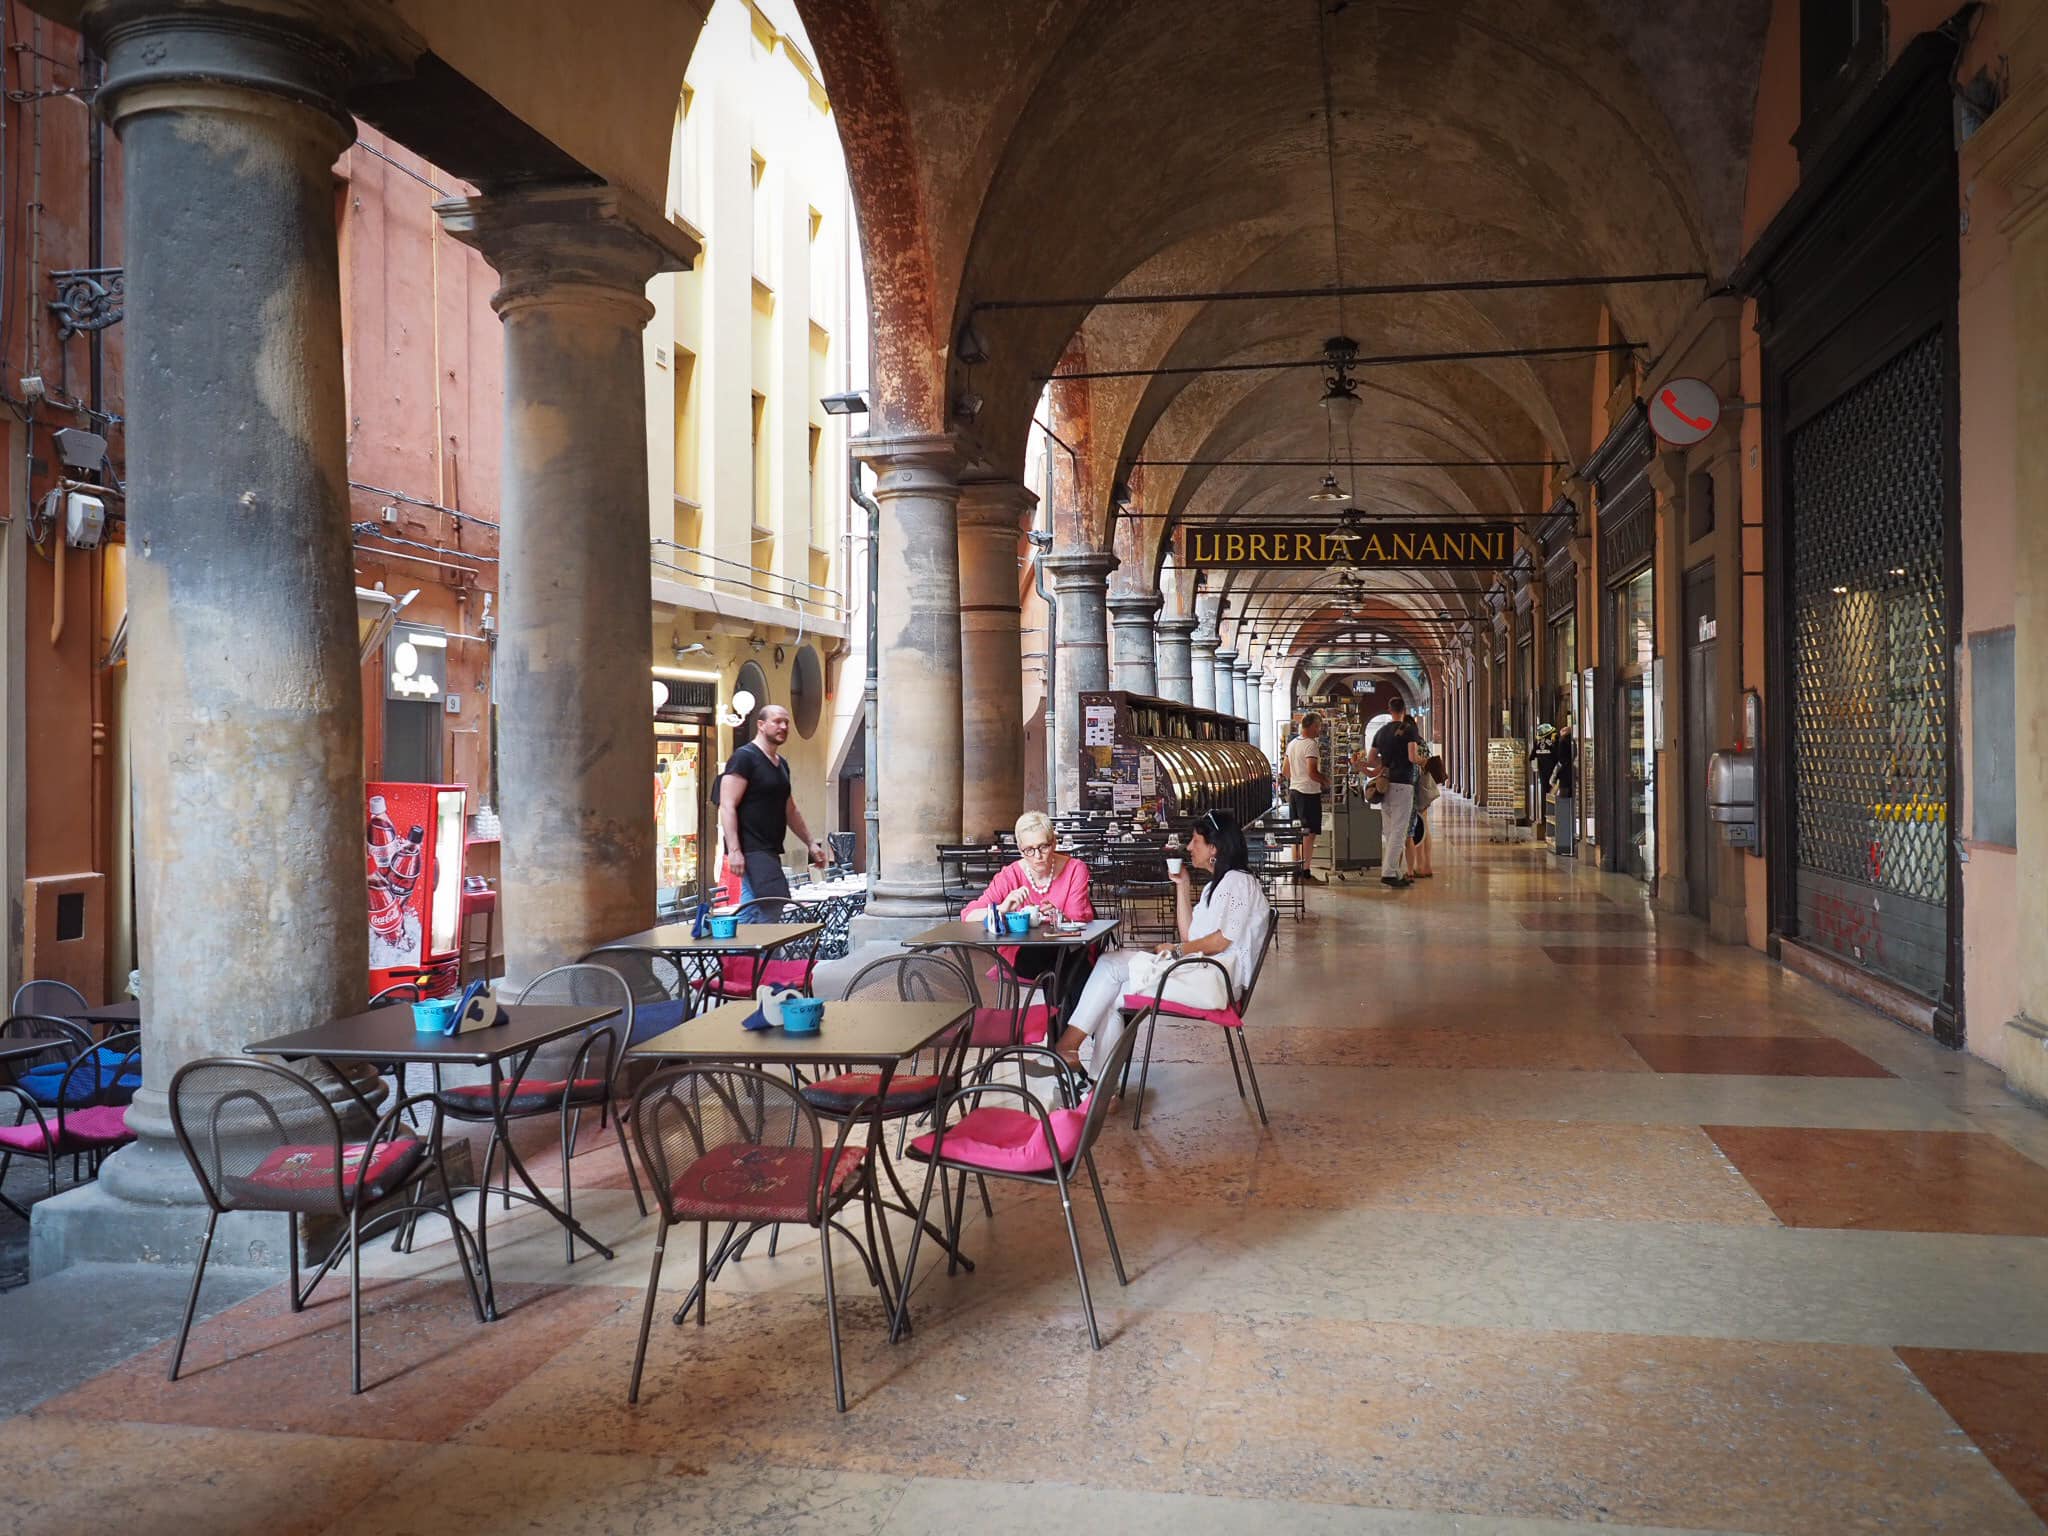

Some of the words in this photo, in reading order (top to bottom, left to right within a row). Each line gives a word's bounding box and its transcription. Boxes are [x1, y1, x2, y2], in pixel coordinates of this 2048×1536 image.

[1195, 533, 1355, 561] LIBRERIA
[1361, 532, 1505, 560] A.NANNI
[450, 699, 456, 710] 9
